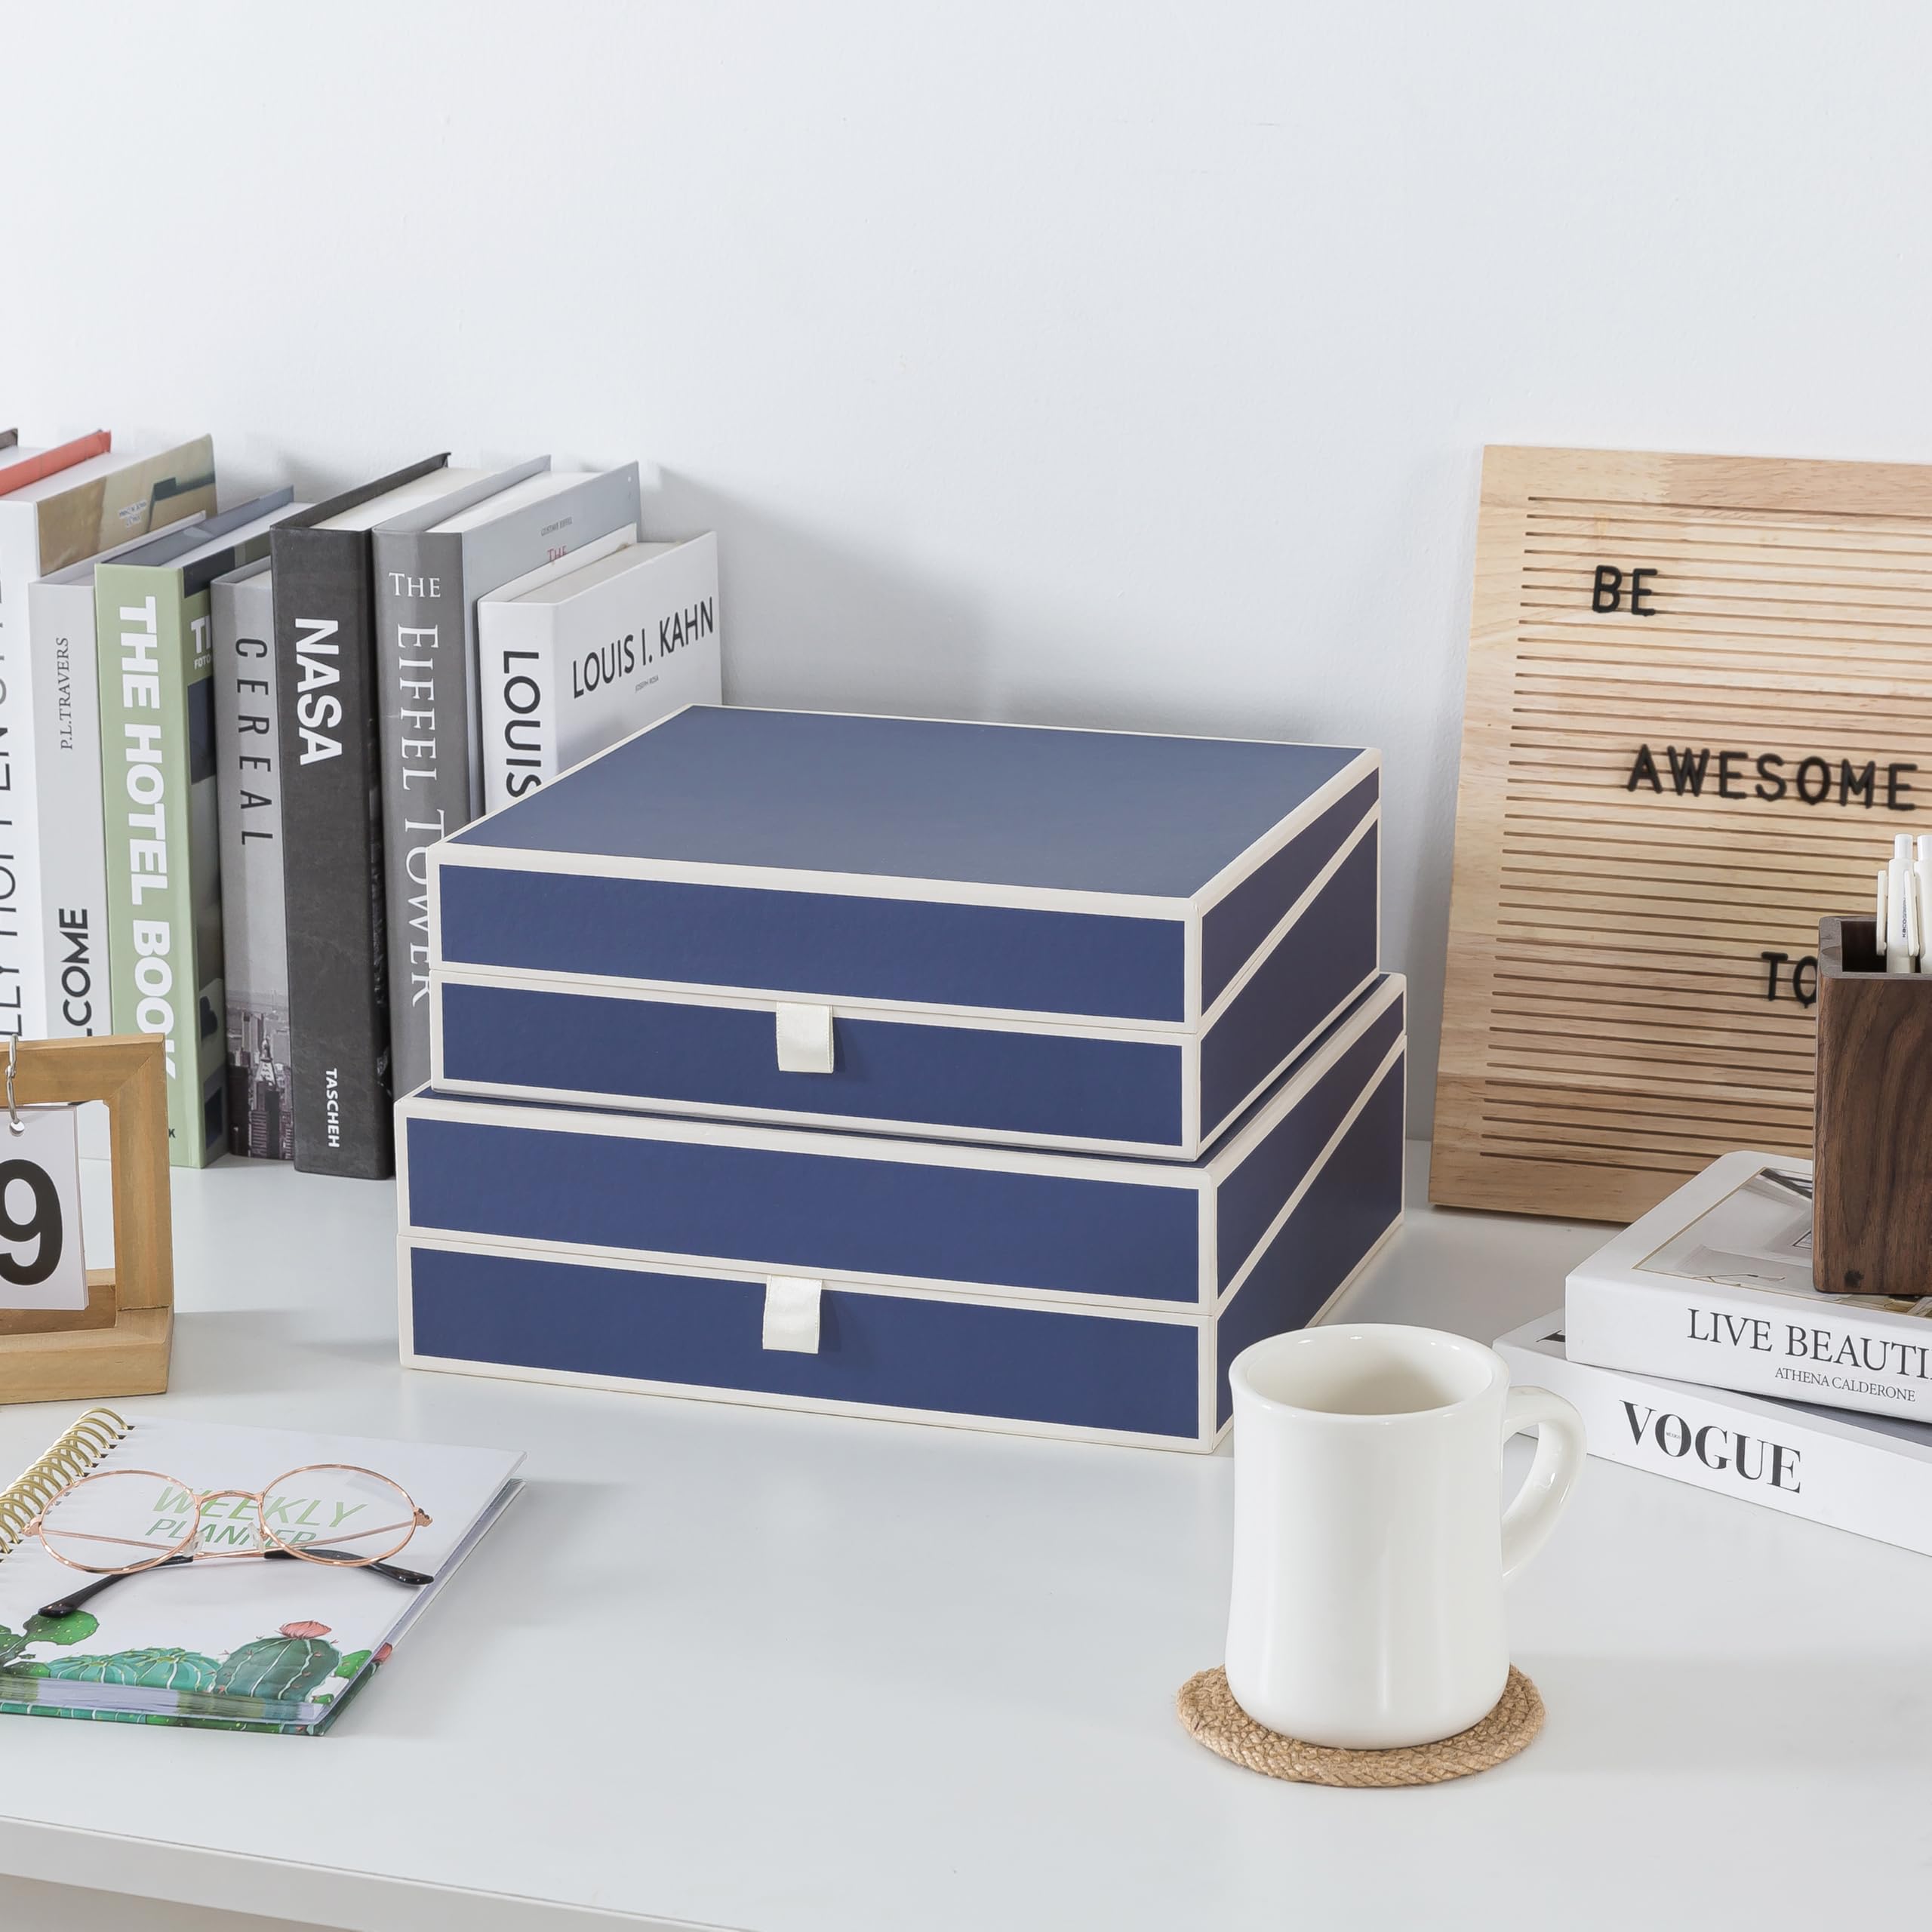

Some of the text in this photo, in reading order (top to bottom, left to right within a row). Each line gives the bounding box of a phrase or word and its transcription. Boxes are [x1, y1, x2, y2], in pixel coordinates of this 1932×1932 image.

[389, 572, 441, 598] THE
[1592, 565, 1658, 617] BE
[295, 618, 343, 765] NASA
[573, 597, 713, 699] LOUIS I. KAHN
[235, 638, 272, 845] CEREAL
[398, 623, 439, 790] EIFFEL
[503, 651, 543, 798] LOUIS
[1626, 743, 1918, 811] AWESOME
[119, 595, 176, 1080] THE HOTEL BOO
[59, 908, 93, 1037] COME
[1761, 951, 1818, 1009] TO
[0, 1158, 63, 1286] 9
[1687, 1308, 1932, 1380] LIVE BEAUTI
[1775, 1367, 1916, 1402] ATHENA CALDERONE
[1620, 1399, 1801, 1494] VOGUE
[152, 1486, 368, 1527] WEEKLY
